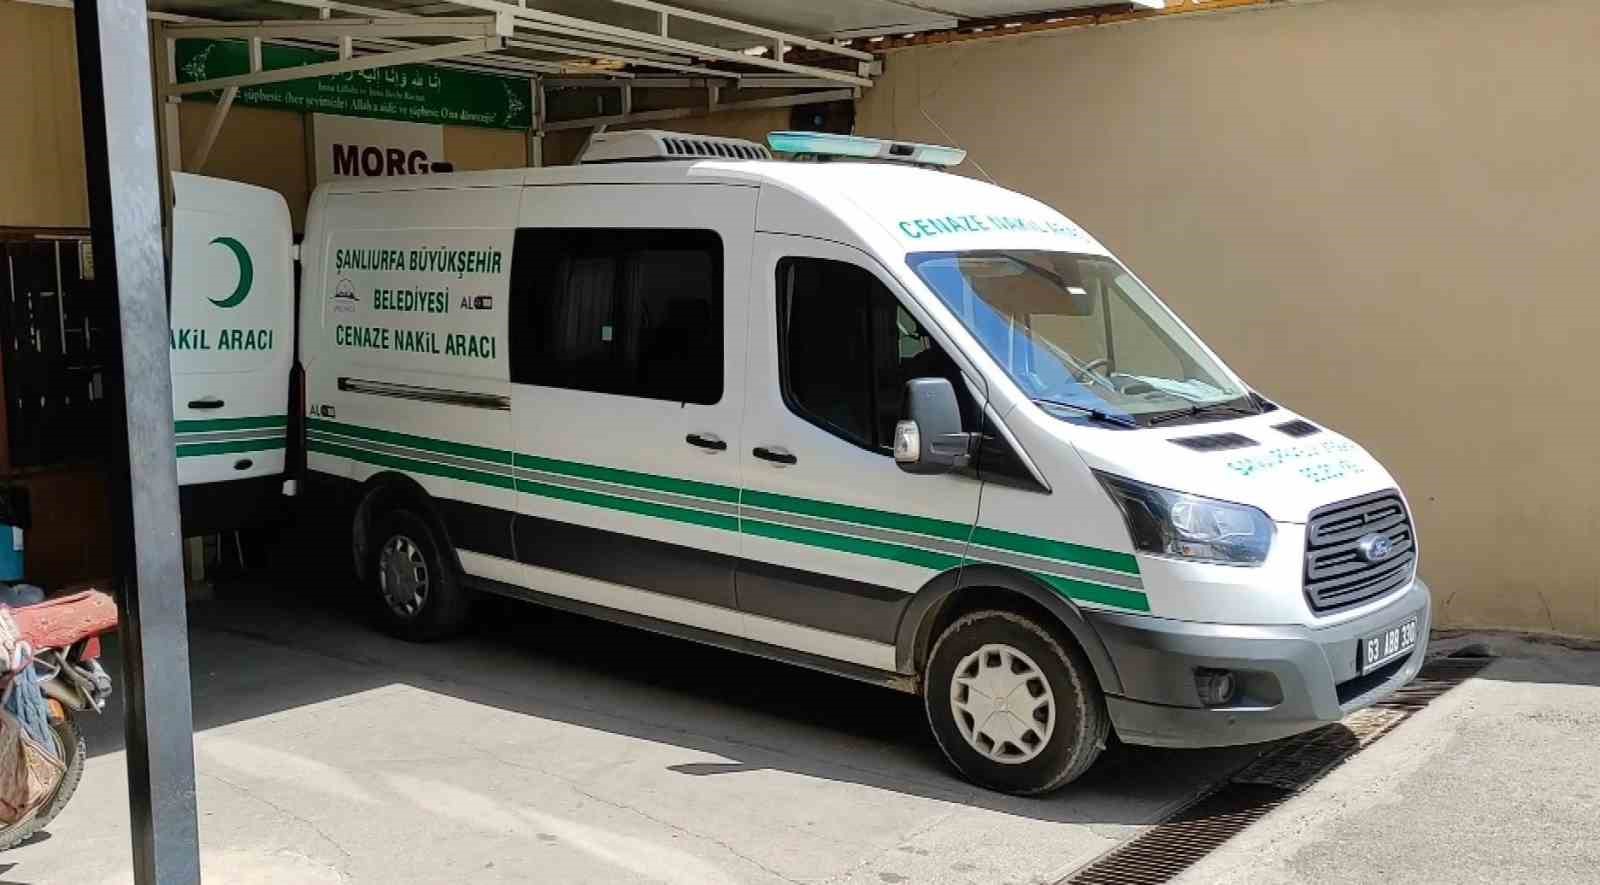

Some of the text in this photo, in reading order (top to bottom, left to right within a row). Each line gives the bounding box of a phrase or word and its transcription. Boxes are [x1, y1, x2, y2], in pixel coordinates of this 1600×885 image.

[898, 214, 990, 239] CENAZE
[335, 246, 502, 279] ŞANLIURFA BÜYÜKŞEHİR
[373, 285, 449, 314] BELEDİYESİ
[217, 329, 273, 350] ARACI
[335, 324, 389, 349] CENAZE
[445, 333, 496, 359] ARACI
[1367, 637, 1380, 663] 63
